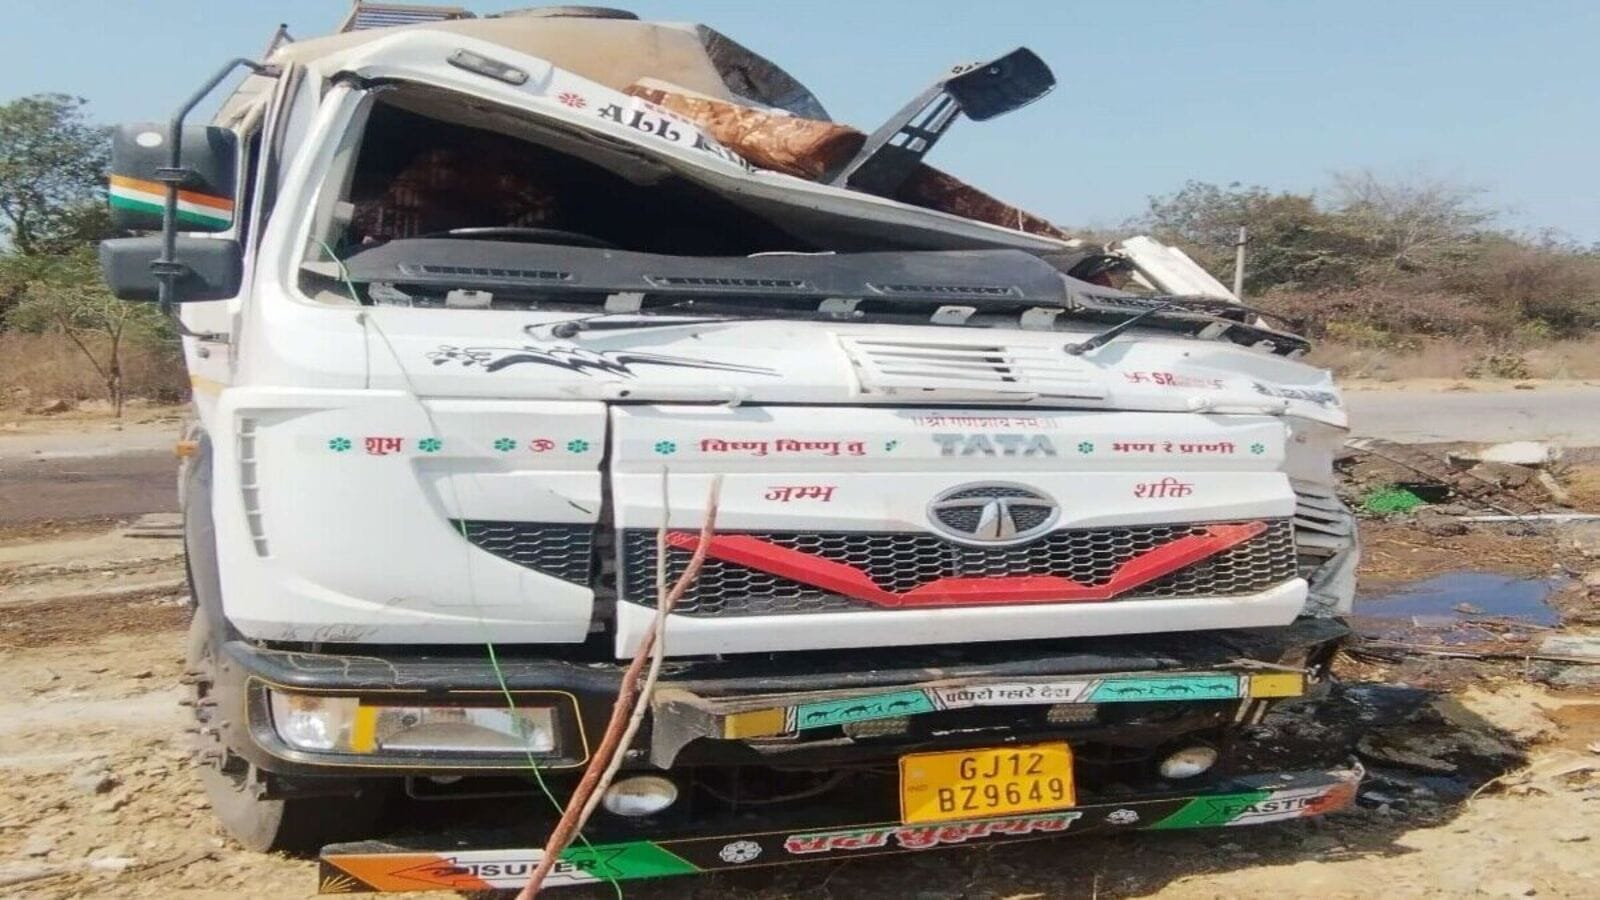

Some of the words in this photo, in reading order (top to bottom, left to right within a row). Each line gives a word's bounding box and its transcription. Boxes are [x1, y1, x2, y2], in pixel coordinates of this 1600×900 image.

[597, 103, 681, 142] ALL
[365, 437, 404, 455] शुभ
[700, 438, 769, 456] विष्णु
[775, 438, 840, 456] विष्णु
[932, 433, 1057, 456] TATA
[1112, 442, 1156, 453] भण
[1161, 440, 1174, 453] रे
[765, 485, 839, 502] जम्भ
[1134, 477, 1195, 498] शक्ति
[938, 778, 1064, 813] BZ9649
[481, 859, 598, 877] SUER
